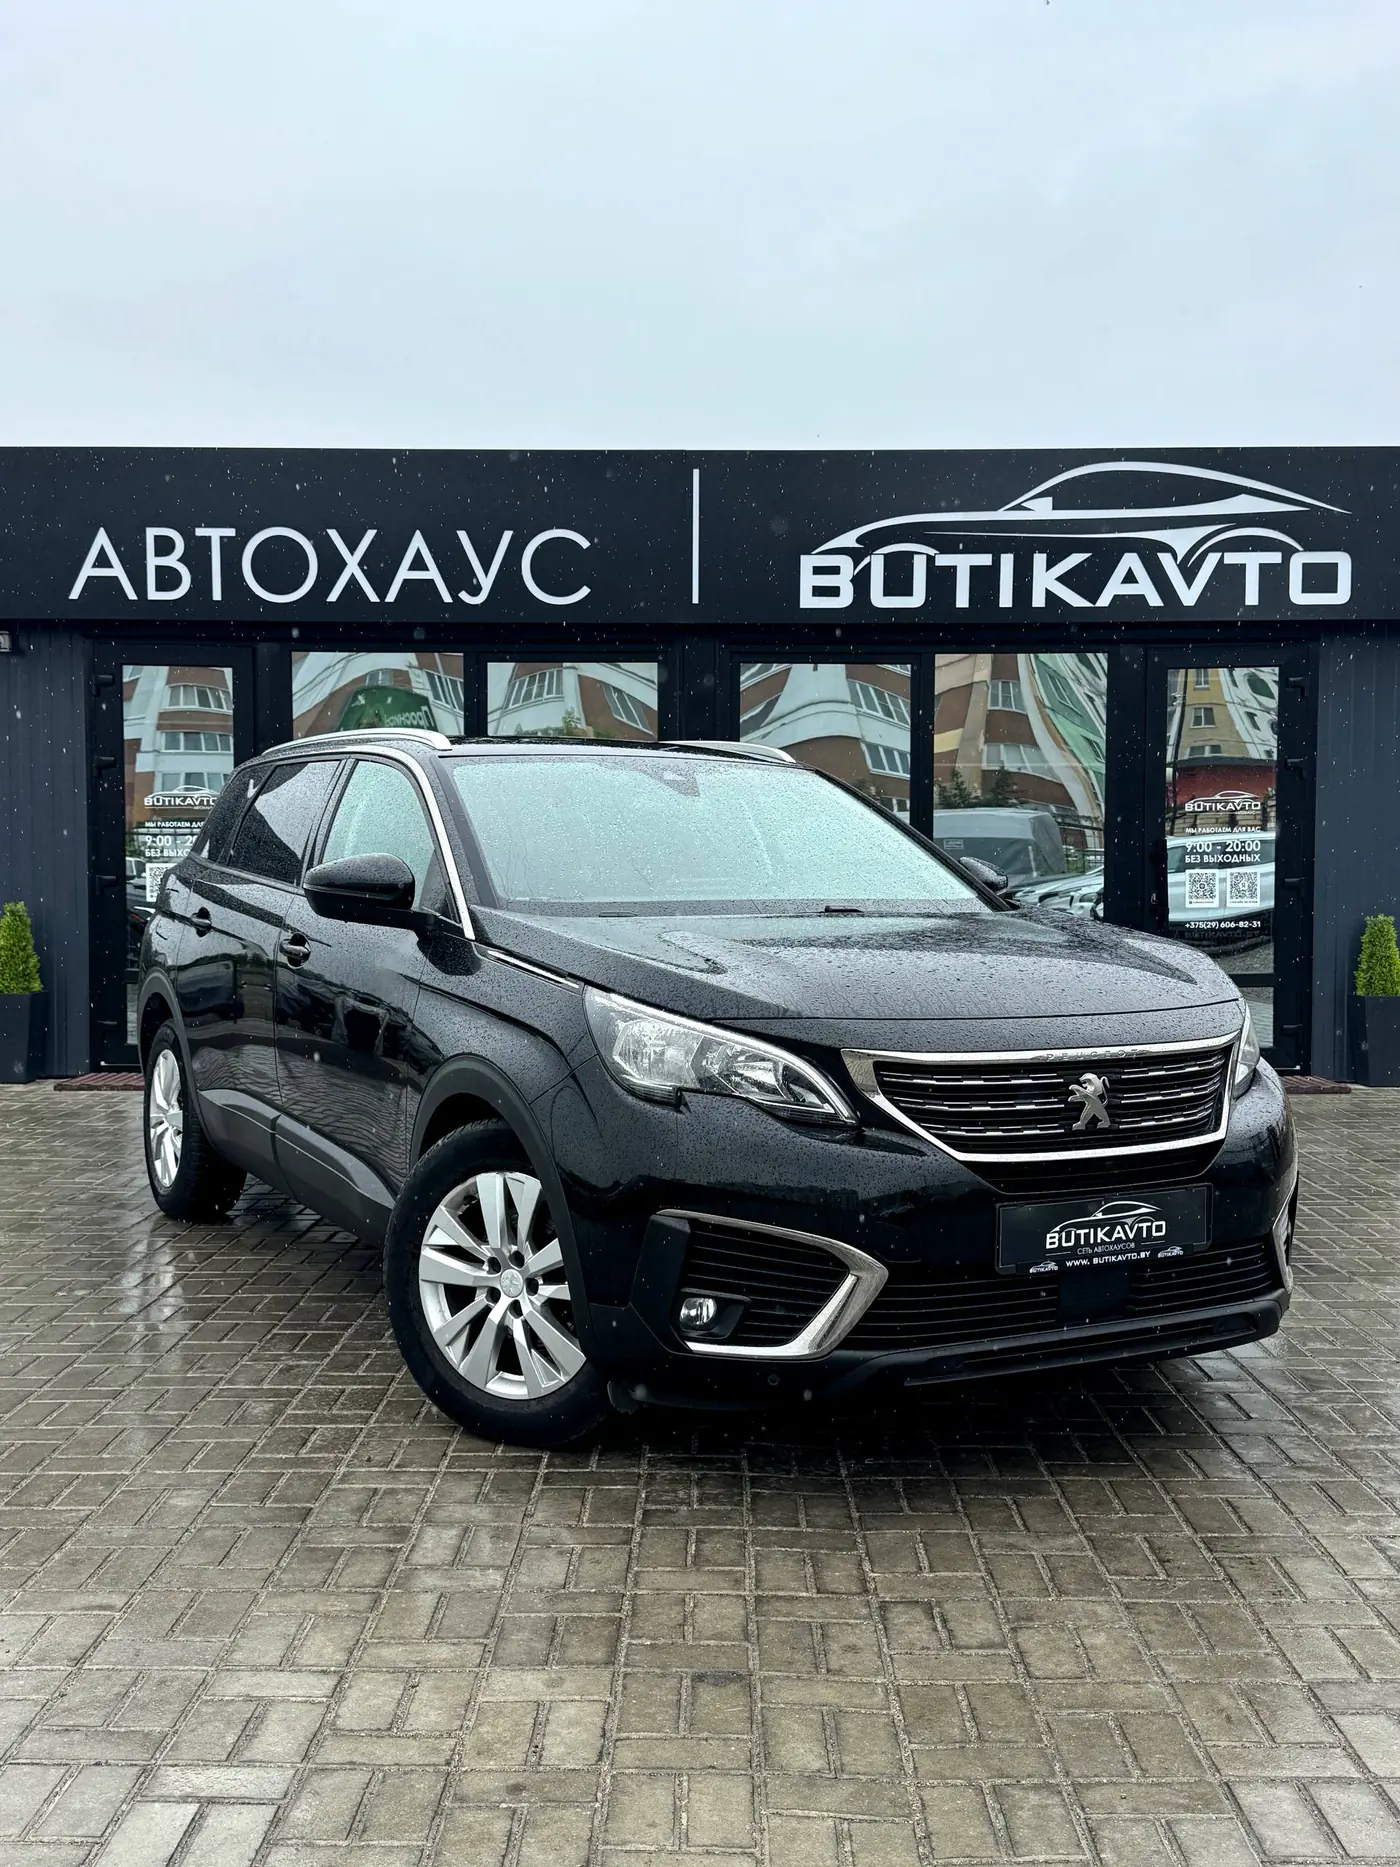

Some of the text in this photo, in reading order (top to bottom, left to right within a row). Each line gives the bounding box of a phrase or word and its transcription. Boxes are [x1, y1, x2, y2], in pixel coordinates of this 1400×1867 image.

[68, 526, 592, 606] АВТОХАУС
[799, 550, 1353, 609] BUTIKAVTO
[1185, 802, 1261, 811] BUTIKAVTO
[145, 835, 172, 846] 9:00
[1185, 841, 1212, 852] 9:00
[1225, 840, 1261, 852] 20:00
[145, 848, 161, 857] БЕЗ
[1185, 853, 1261, 863] БЕЗ ВЫХОДНЫХ
[1185, 920, 1261, 929] +375(29) 606-82-31
[1045, 1220, 1166, 1249] BUTIKAVTO
[1065, 1251, 1151, 1268] WWW. BUTIKAVTO.BY
